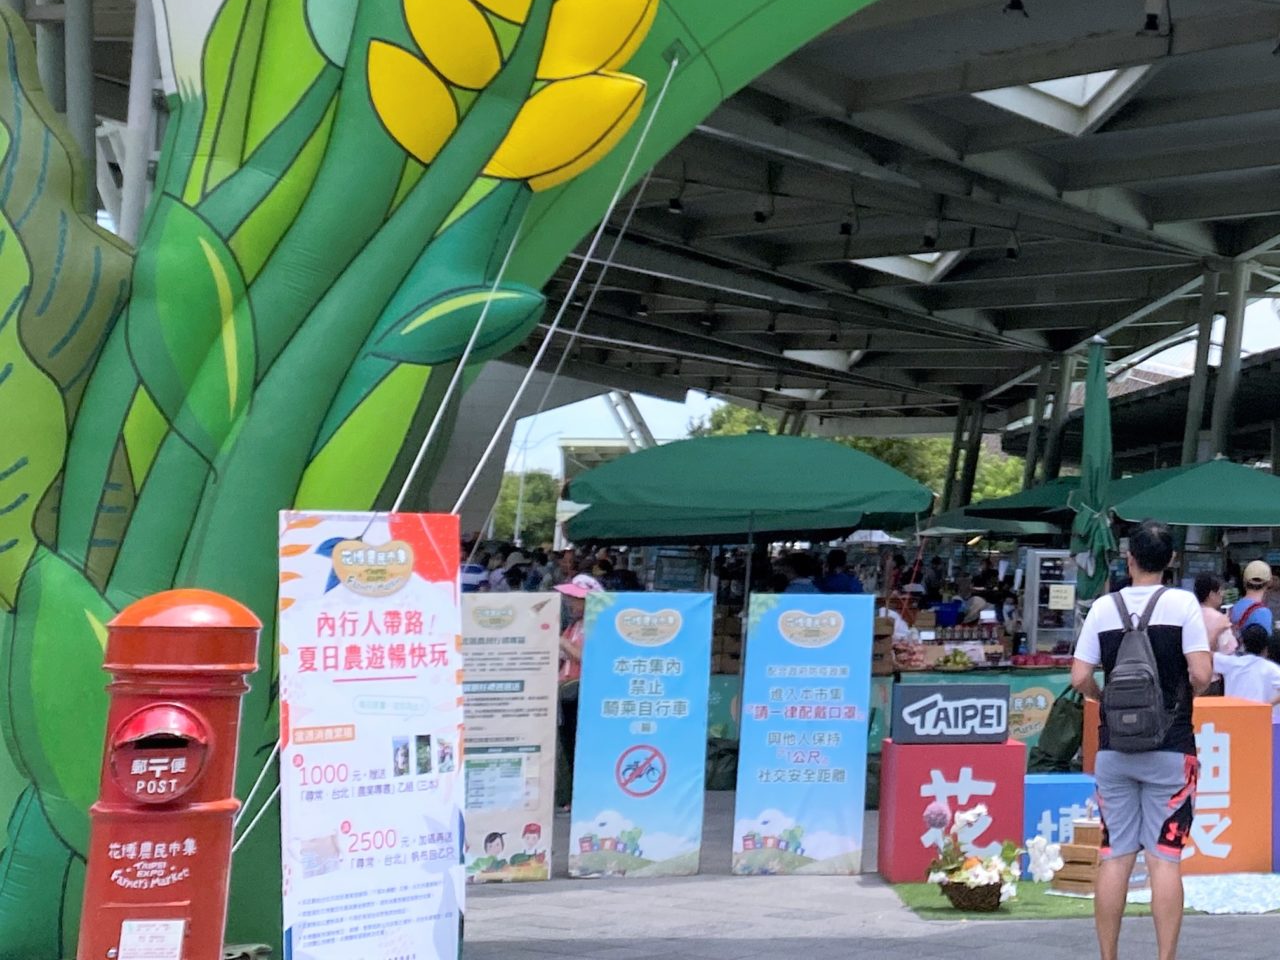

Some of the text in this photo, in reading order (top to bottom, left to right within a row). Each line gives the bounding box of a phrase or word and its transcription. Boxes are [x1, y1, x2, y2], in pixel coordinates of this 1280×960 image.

[297, 642, 449, 673] 夏日農遊暢快玩
[614, 658, 682, 675] 本市集內
[630, 679, 664, 696] 禁止
[771, 688, 843, 701] 進入本市集
[602, 700, 688, 717] 騎乘自行車
[904, 695, 1006, 734] TAIPEI
[299, 763, 349, 786] 1000
[758, 768, 847, 783] 社交安全距離
[136, 778, 178, 794] POST
[920, 767, 1003, 858] 花
[108, 838, 198, 860] 花博農民市集
[347, 829, 397, 853] 2500
